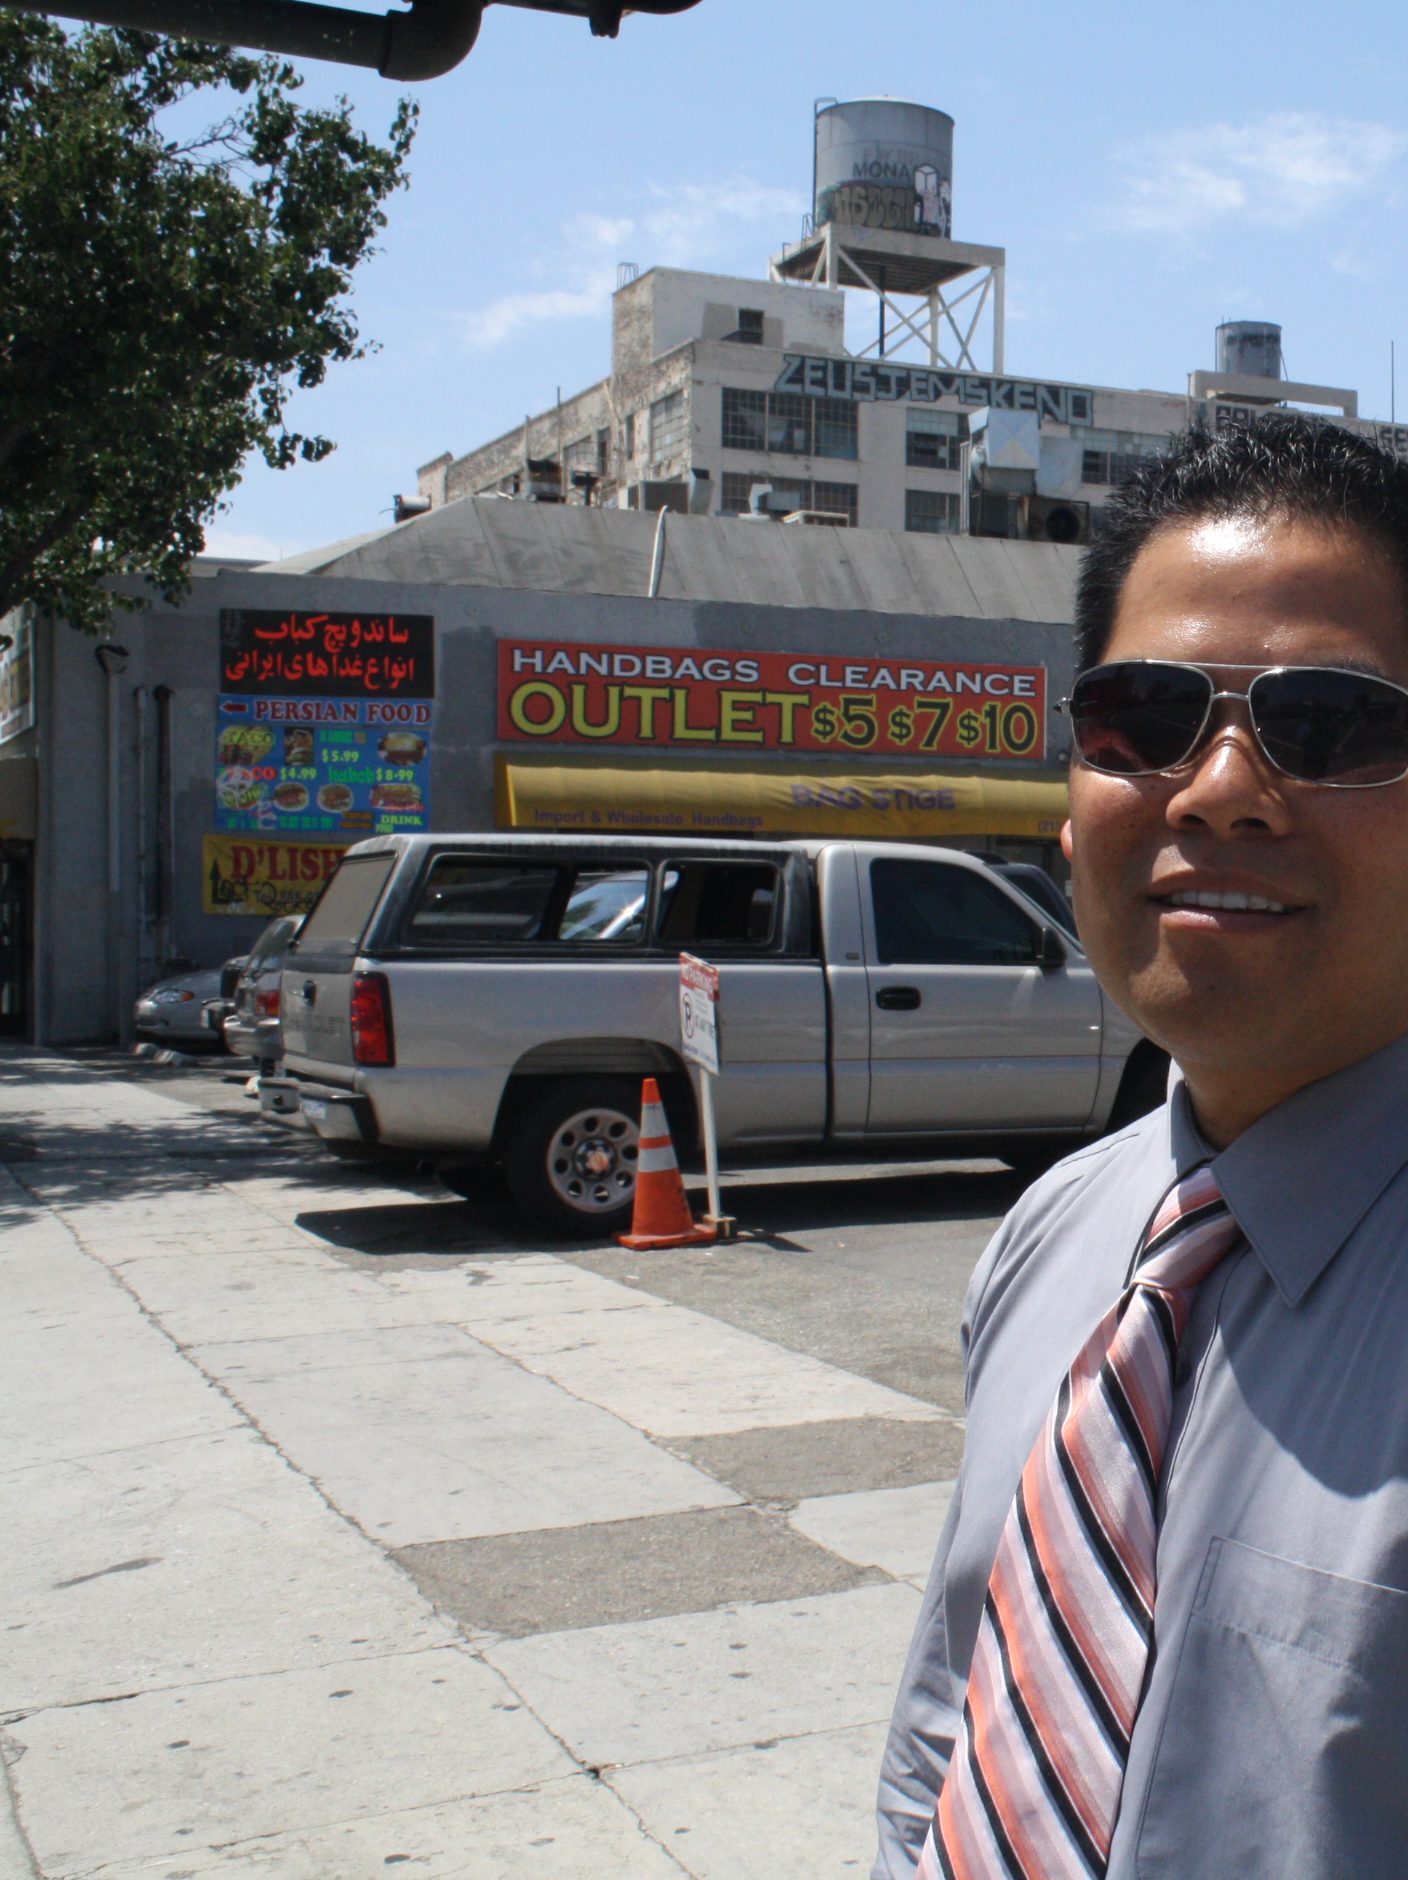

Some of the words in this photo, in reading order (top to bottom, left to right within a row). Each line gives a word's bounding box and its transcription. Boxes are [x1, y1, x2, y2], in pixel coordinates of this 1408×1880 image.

[513, 649, 760, 683] HANDBAGS
[787, 663, 1036, 697] CLEARANCE
[254, 700, 359, 722] PERSIAN
[367, 703, 431, 723] FOOD
[510, 681, 810, 743] OUTLET
[811, 694, 878, 748] $5
[888, 696, 952, 750] $7
[957, 701, 1037, 754] $10
[791, 784, 864, 810] BAG
[535, 809, 585, 825] Import
[607, 810, 683, 825] Wholesale
[692, 812, 764, 829] Handbags
